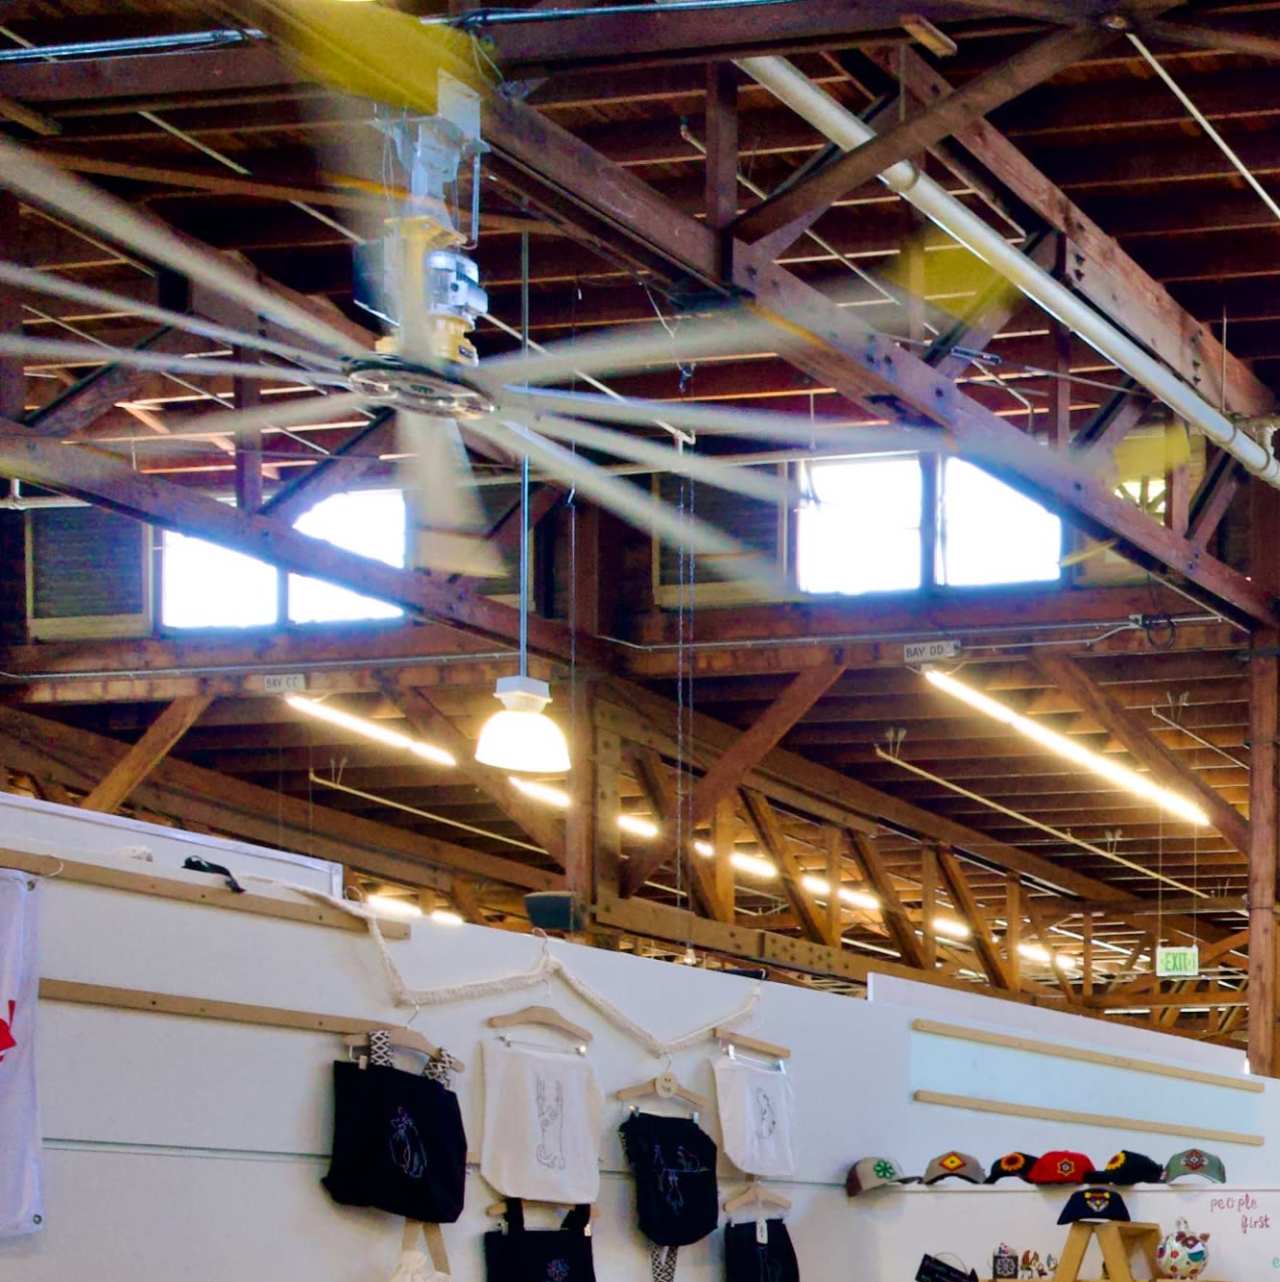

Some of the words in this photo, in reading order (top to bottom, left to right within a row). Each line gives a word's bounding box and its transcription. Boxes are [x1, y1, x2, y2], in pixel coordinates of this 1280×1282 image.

[906, 647, 926, 659] BAY
[1165, 952, 1187, 971] EXIT
[1241, 1214, 1270, 1234] first
